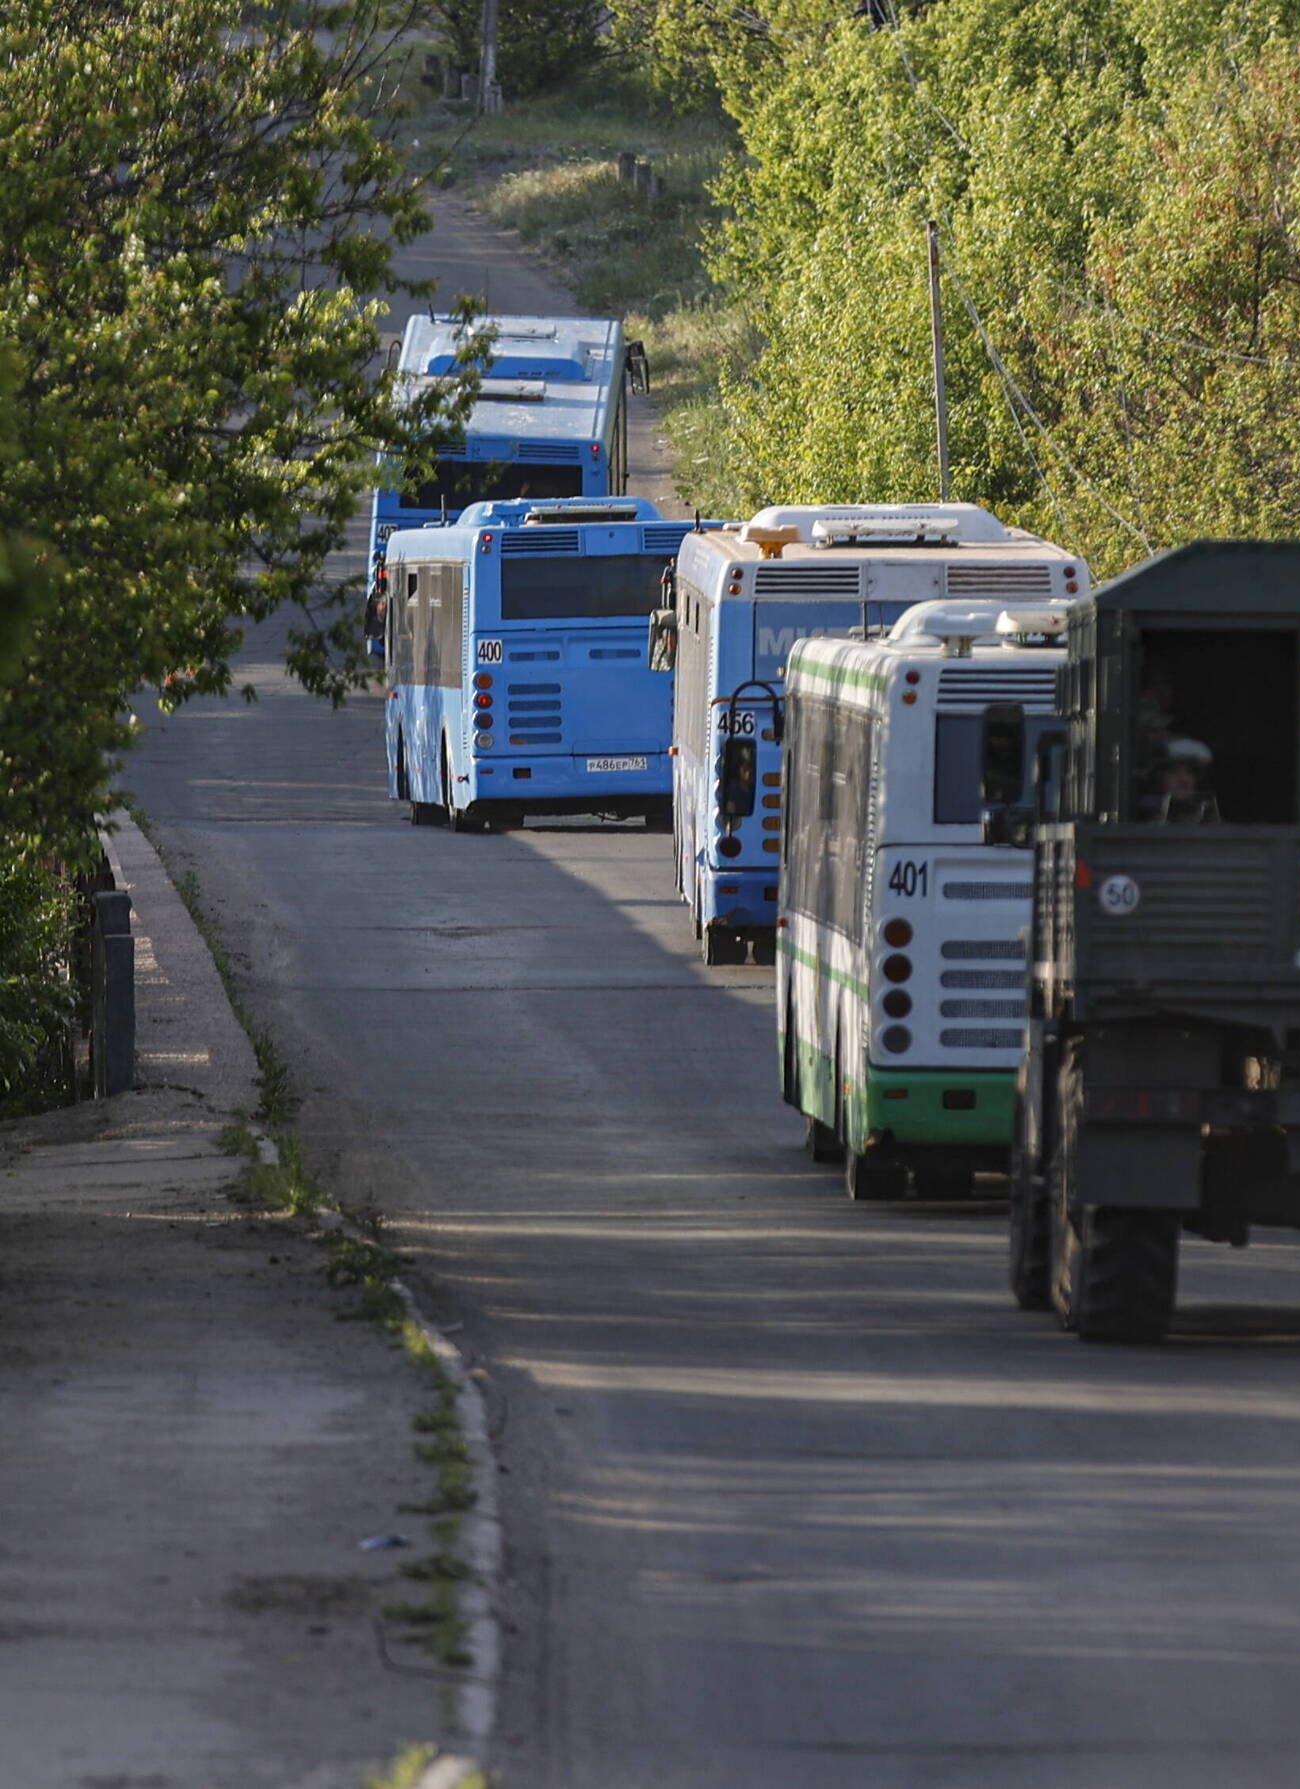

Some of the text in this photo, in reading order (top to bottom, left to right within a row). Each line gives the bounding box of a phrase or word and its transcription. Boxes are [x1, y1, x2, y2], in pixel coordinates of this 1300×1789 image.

[478, 641, 502, 662] 400
[889, 860, 928, 897] 401
[1108, 884, 1135, 905] 50
